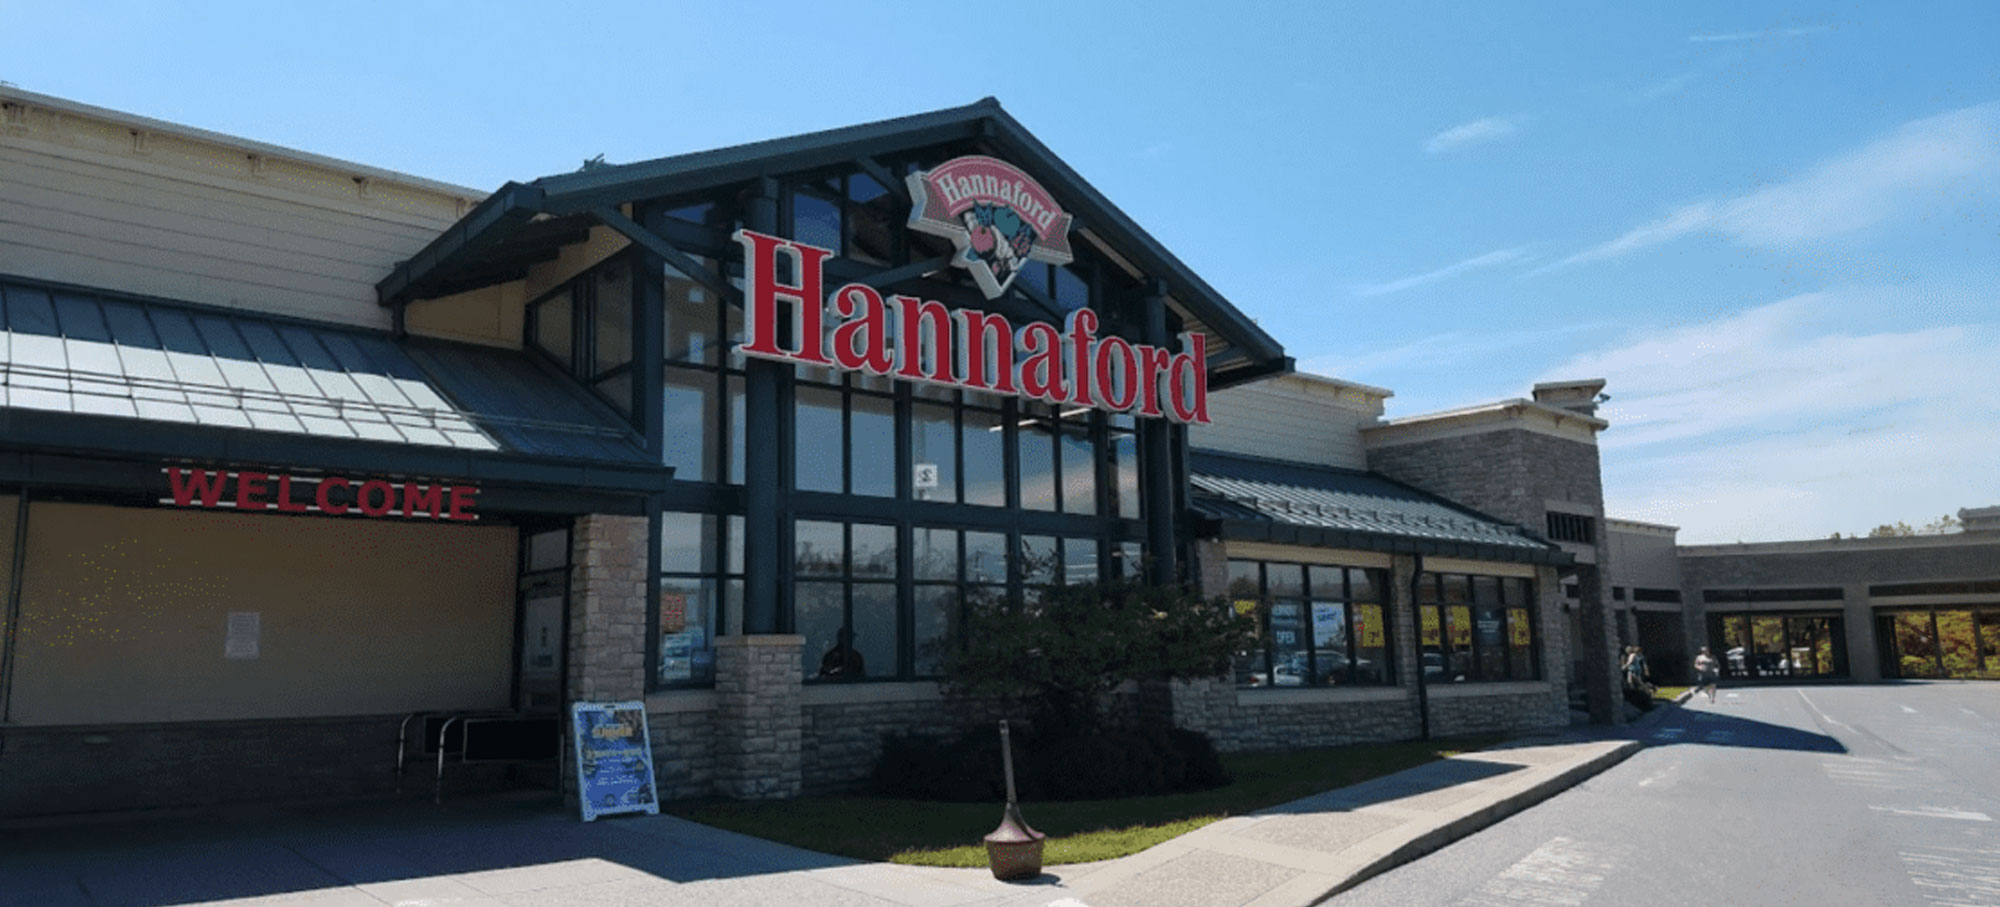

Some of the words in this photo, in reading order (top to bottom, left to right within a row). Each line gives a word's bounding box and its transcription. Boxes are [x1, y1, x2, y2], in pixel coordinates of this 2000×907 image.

[936, 172, 1057, 232] Hannaford
[733, 229, 1211, 424] Hannaford
[167, 466, 477, 520] WELCOME
